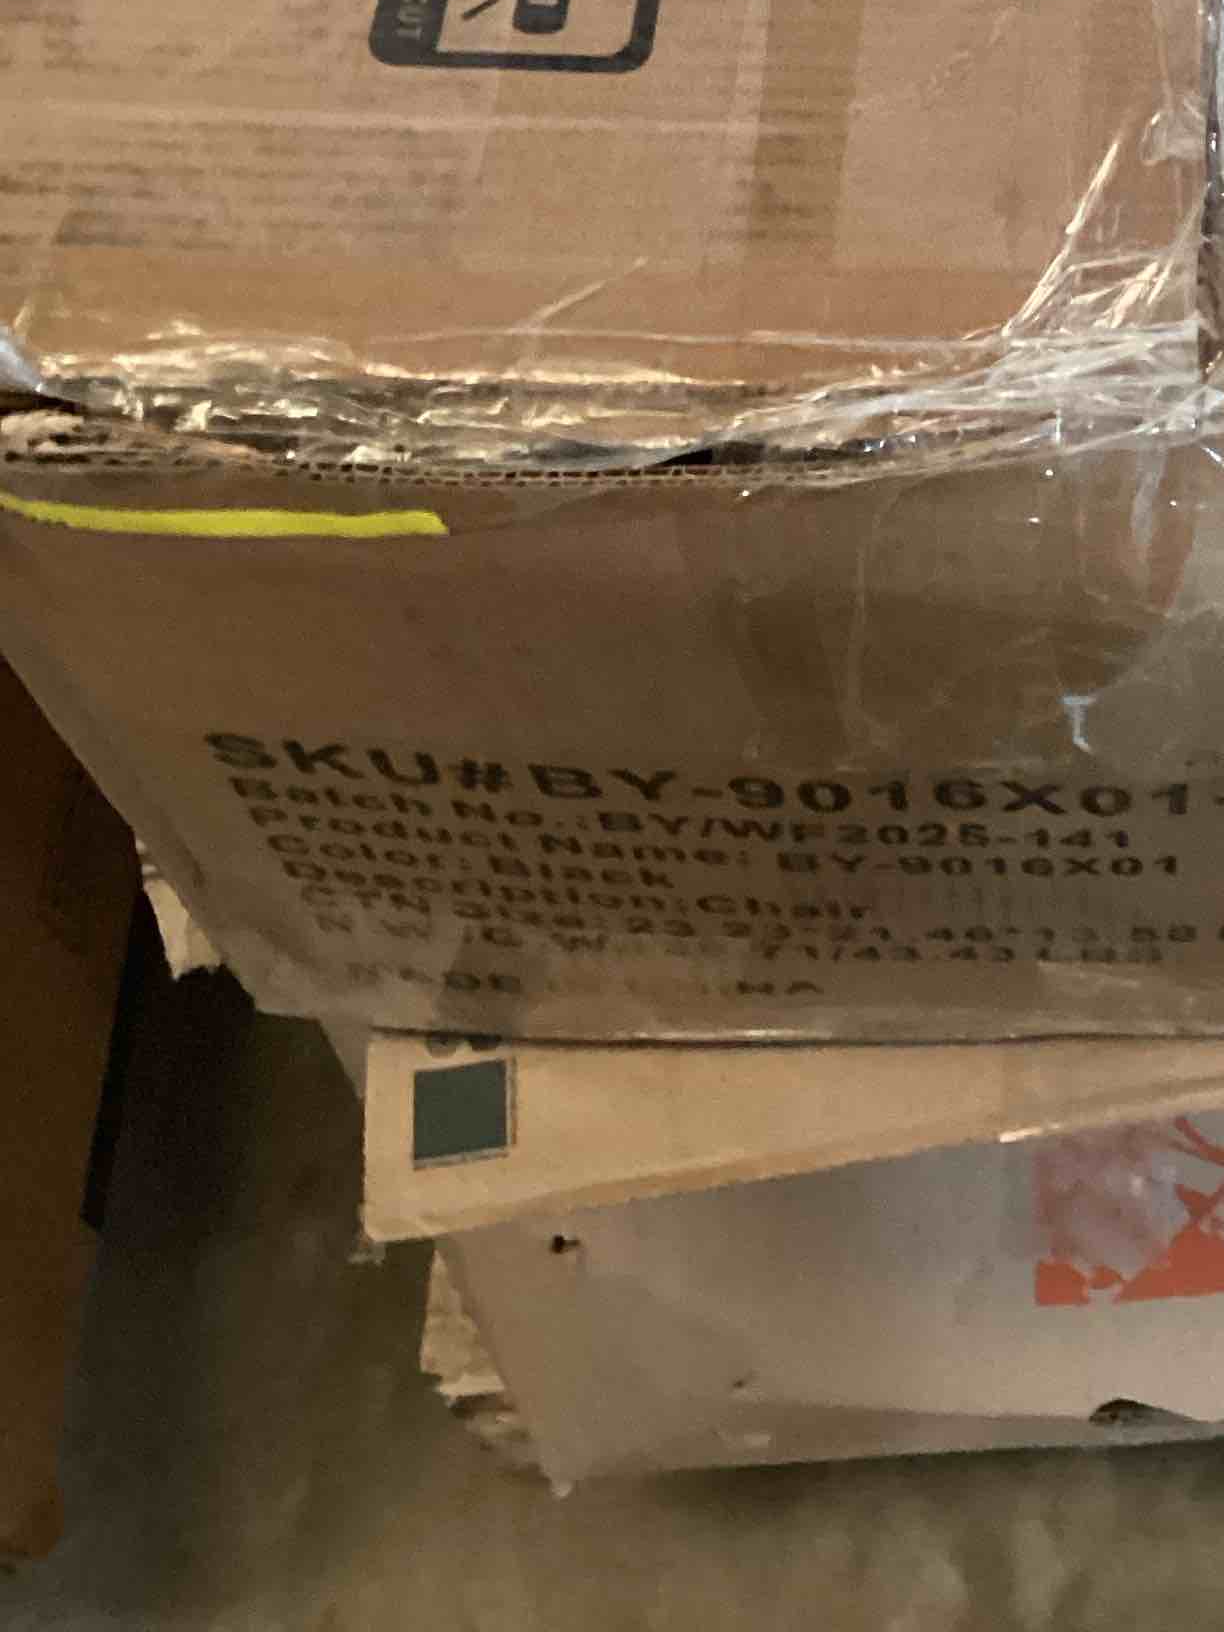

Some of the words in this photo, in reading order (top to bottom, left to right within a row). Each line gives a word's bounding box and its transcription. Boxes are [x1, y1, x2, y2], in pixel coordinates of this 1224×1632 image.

[228, 775, 434, 815] Batch
[250, 806, 517, 852] Product
[776, 851, 1178, 877] BY-9016X01
